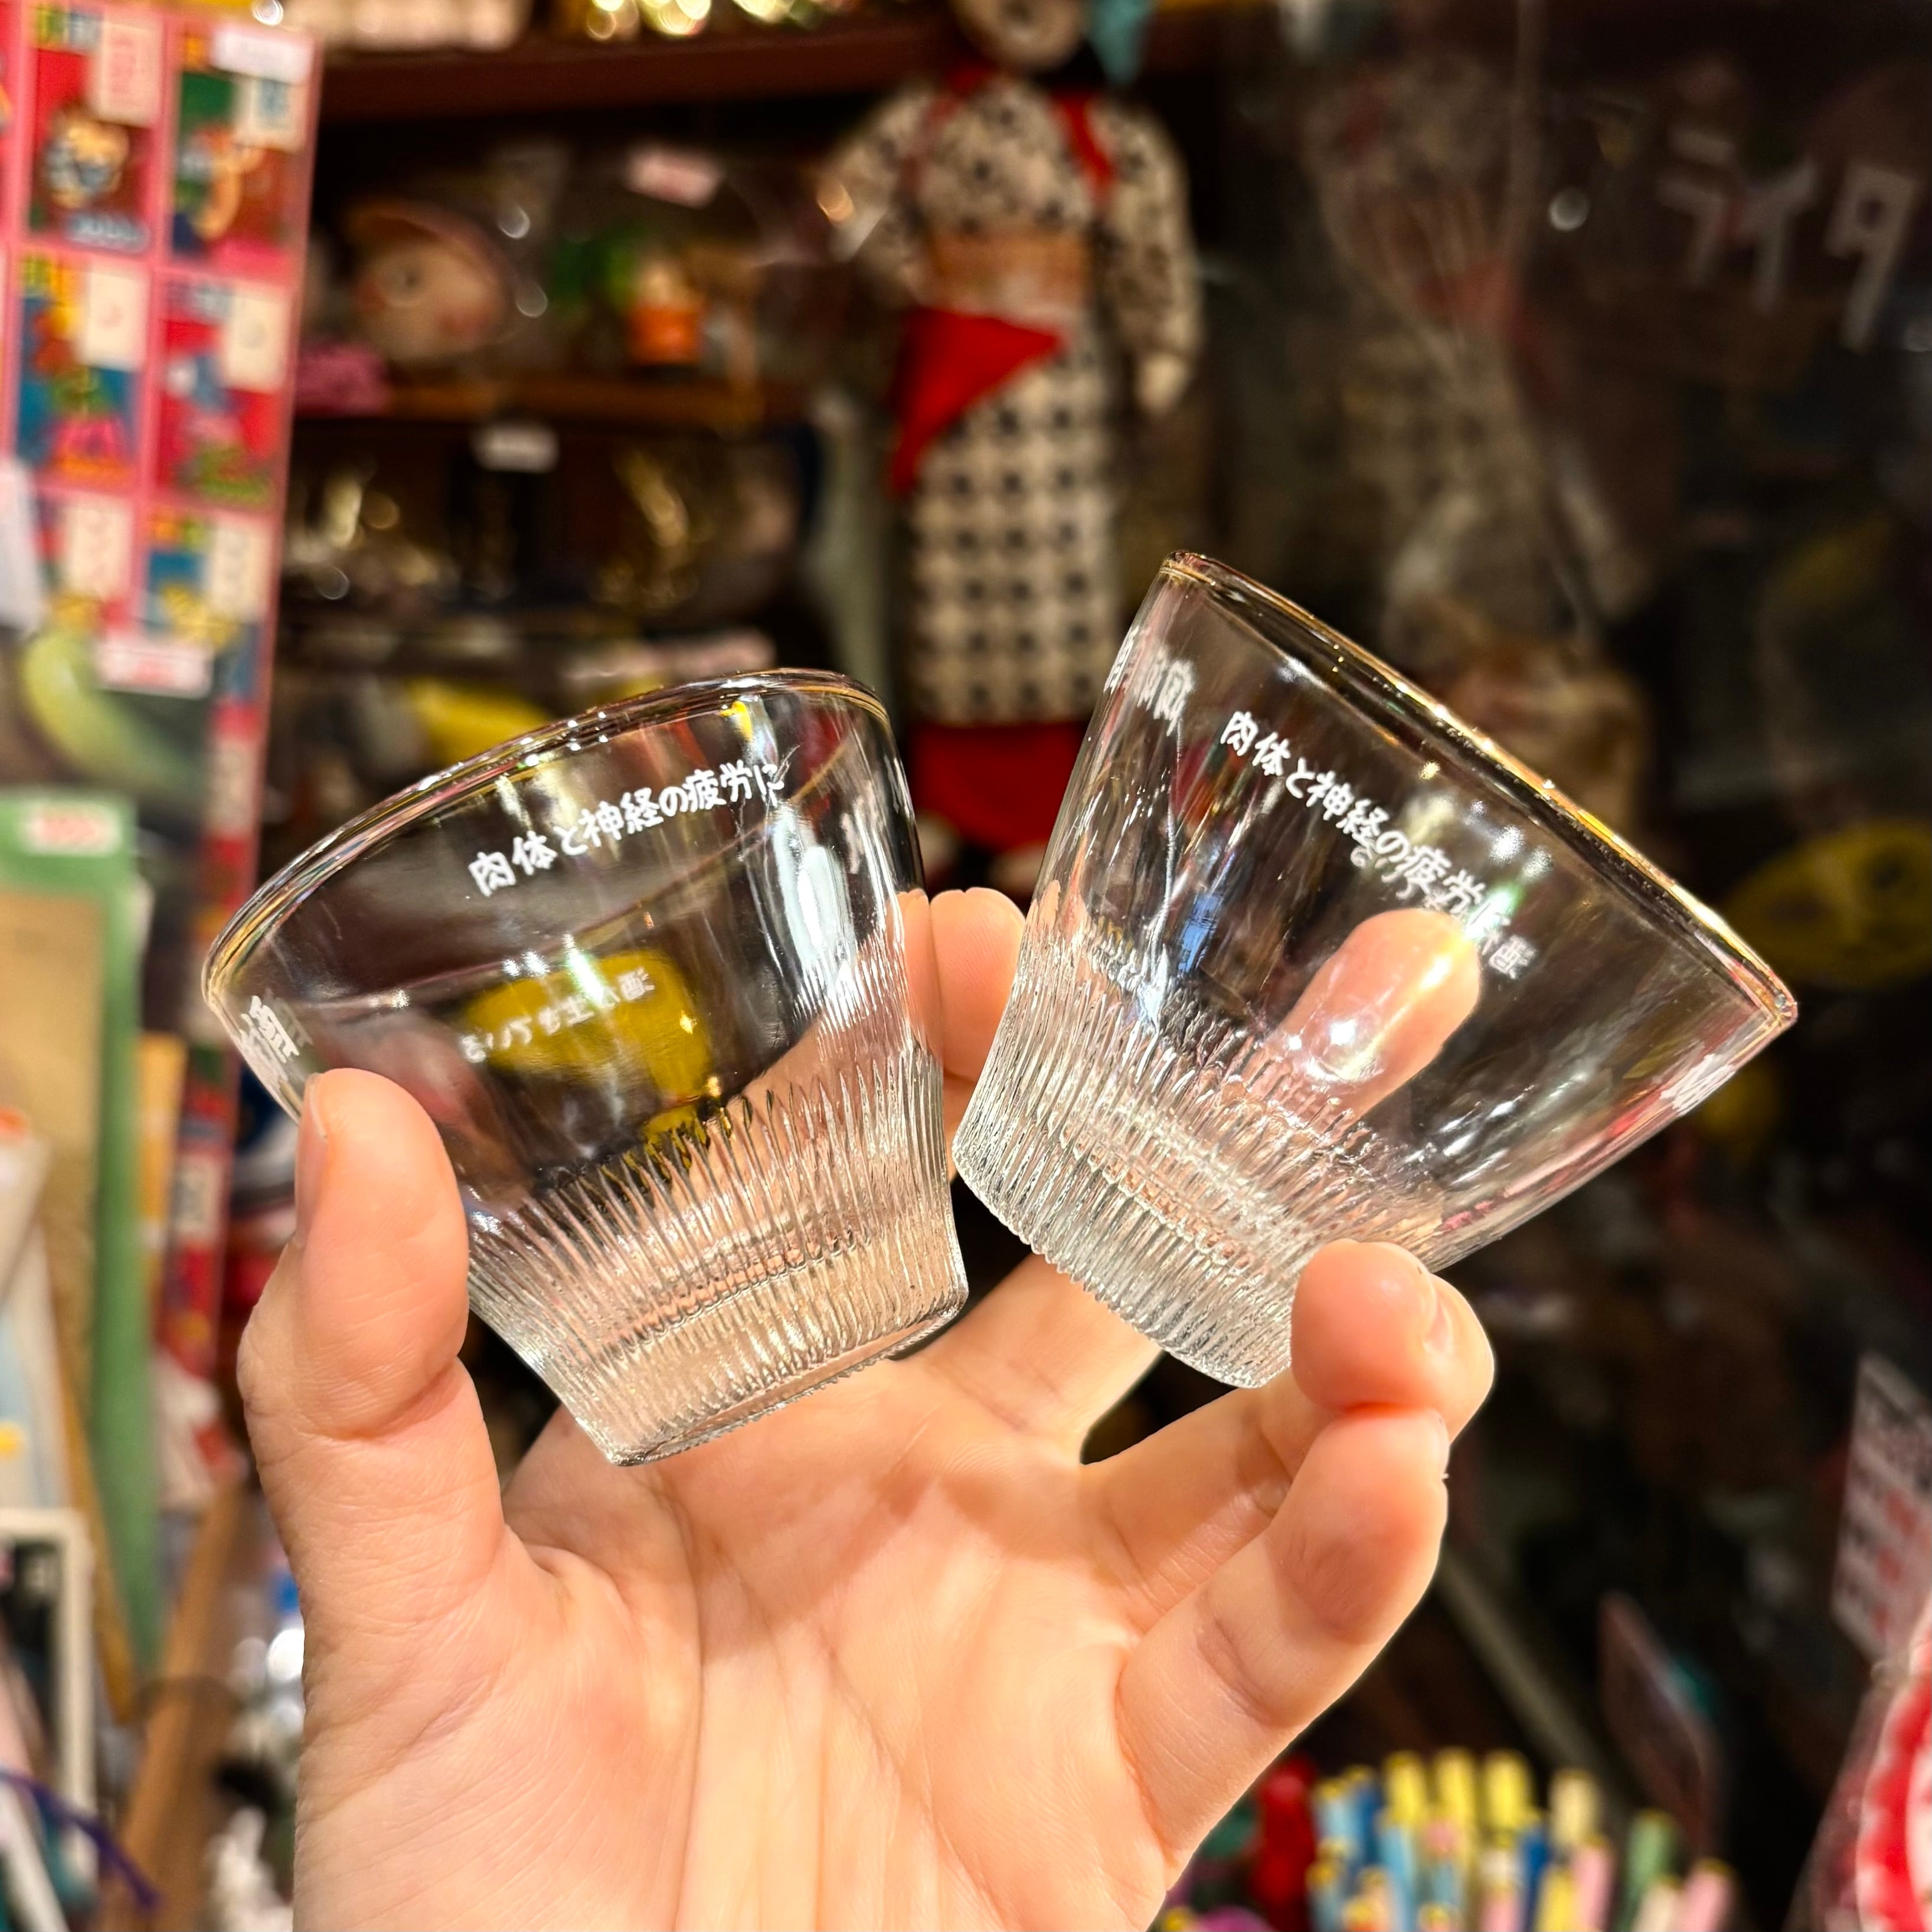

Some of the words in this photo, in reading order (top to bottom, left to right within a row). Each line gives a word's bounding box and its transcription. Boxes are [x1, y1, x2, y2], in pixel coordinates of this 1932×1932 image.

[468, 759, 786, 898] 肉体と神経の疲労に
